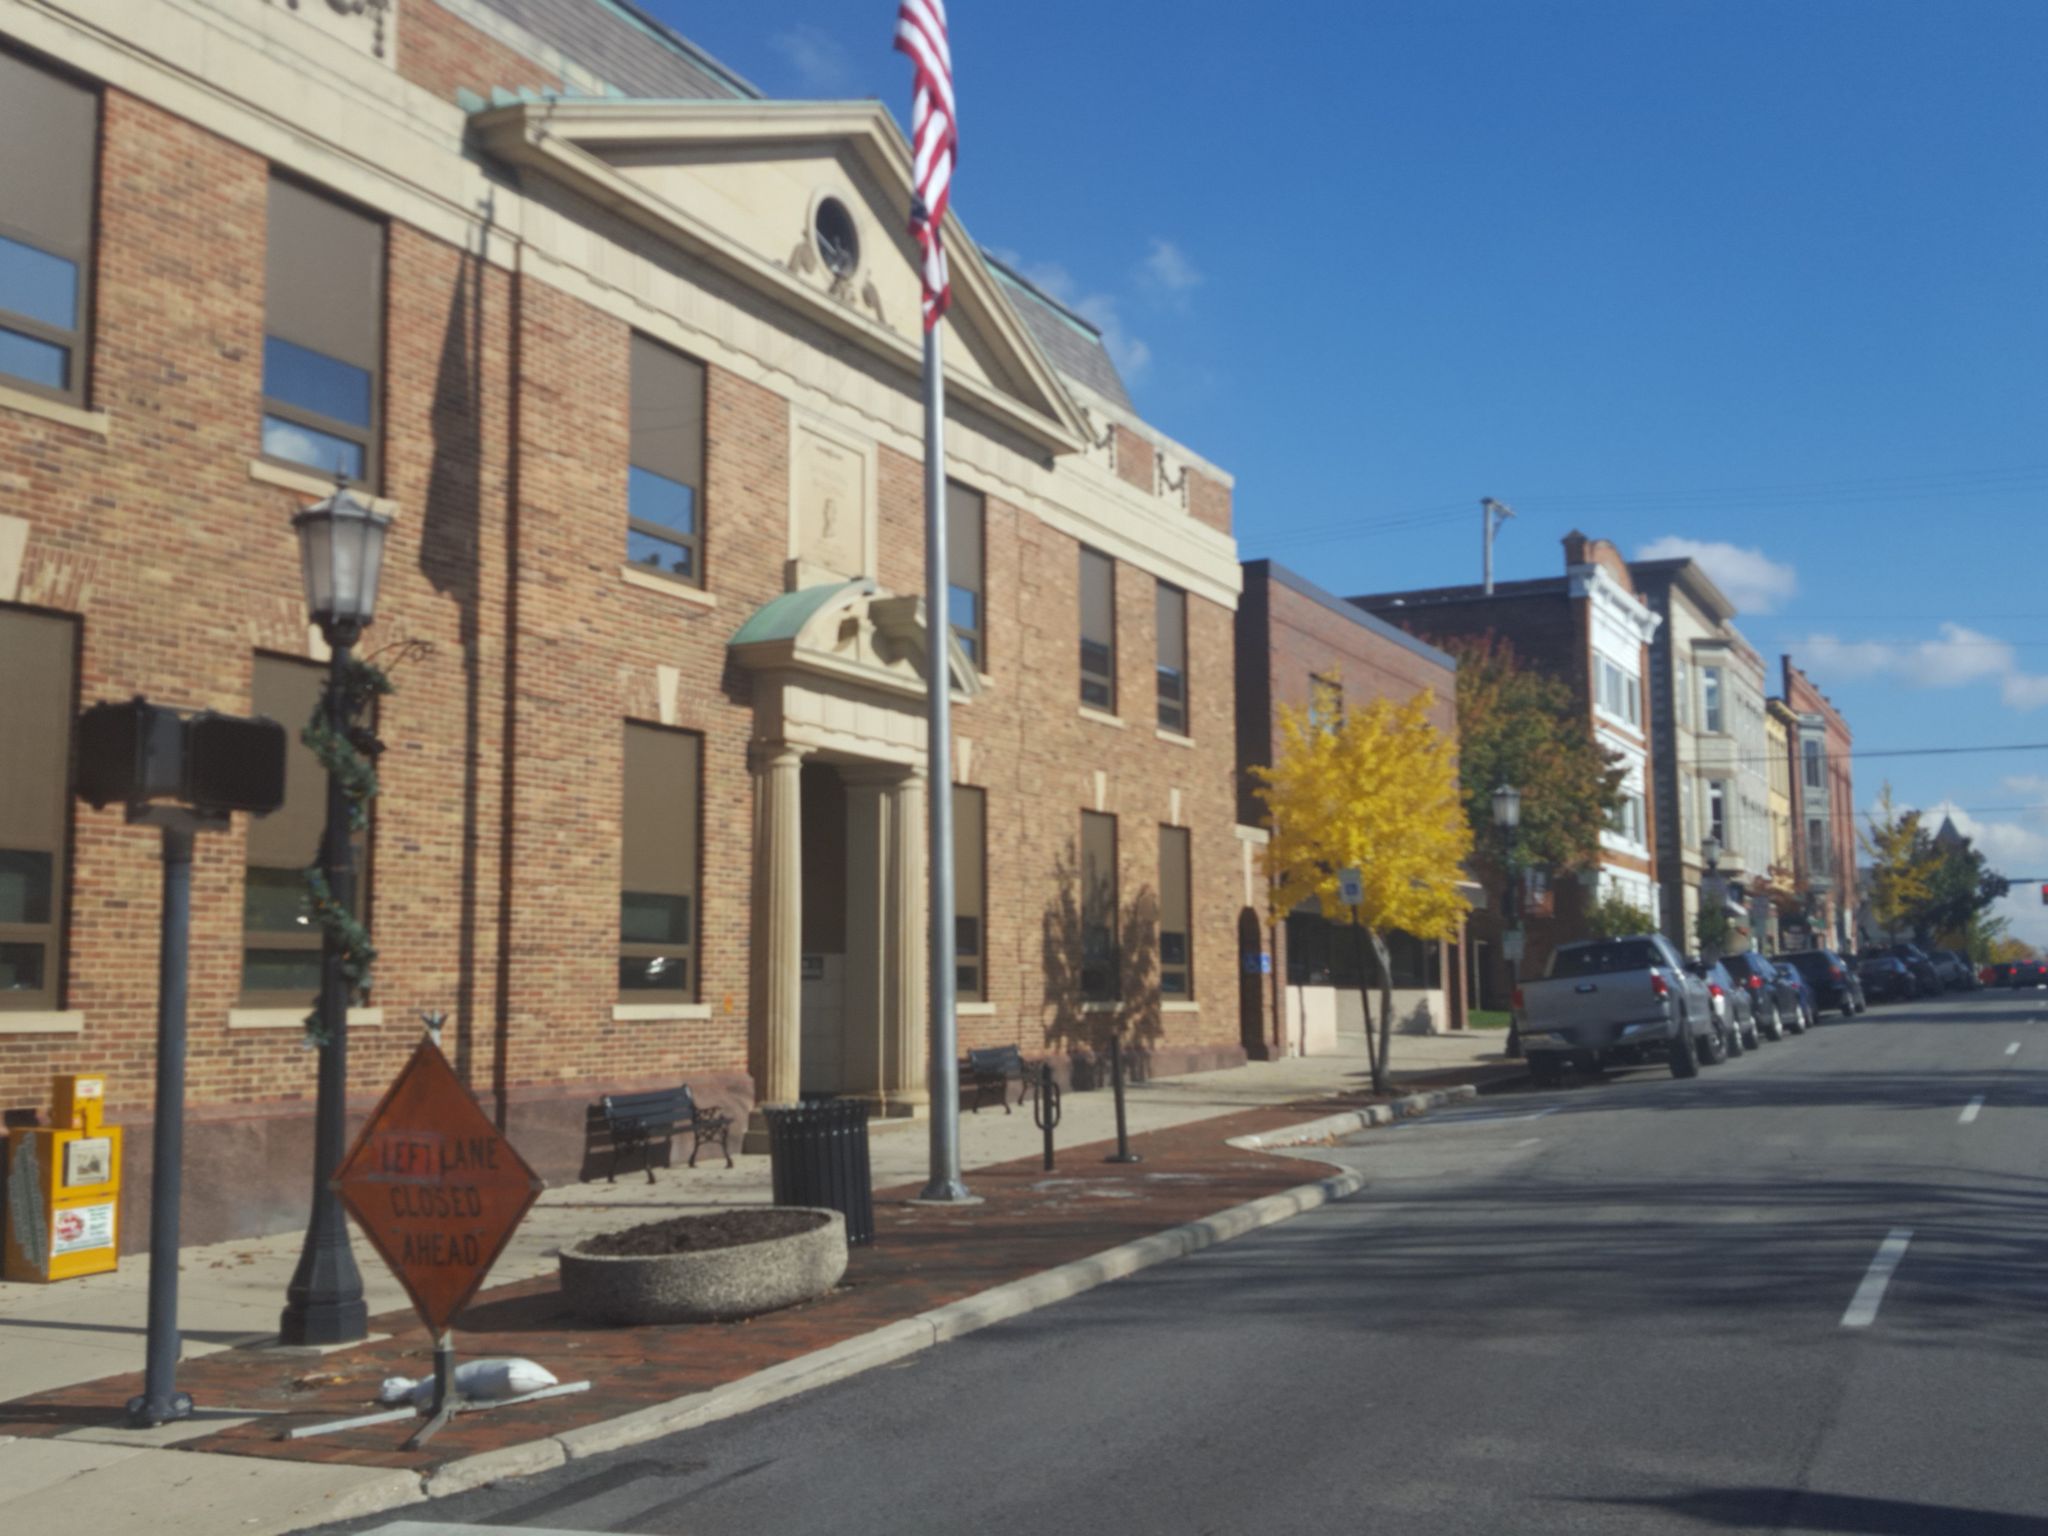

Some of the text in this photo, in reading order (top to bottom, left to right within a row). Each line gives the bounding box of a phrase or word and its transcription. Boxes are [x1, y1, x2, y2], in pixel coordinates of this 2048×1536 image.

[382, 1136, 499, 1174] LEFT LANE
[390, 1184, 482, 1218] CLOSED
[402, 1232, 479, 1267] AHEAD
